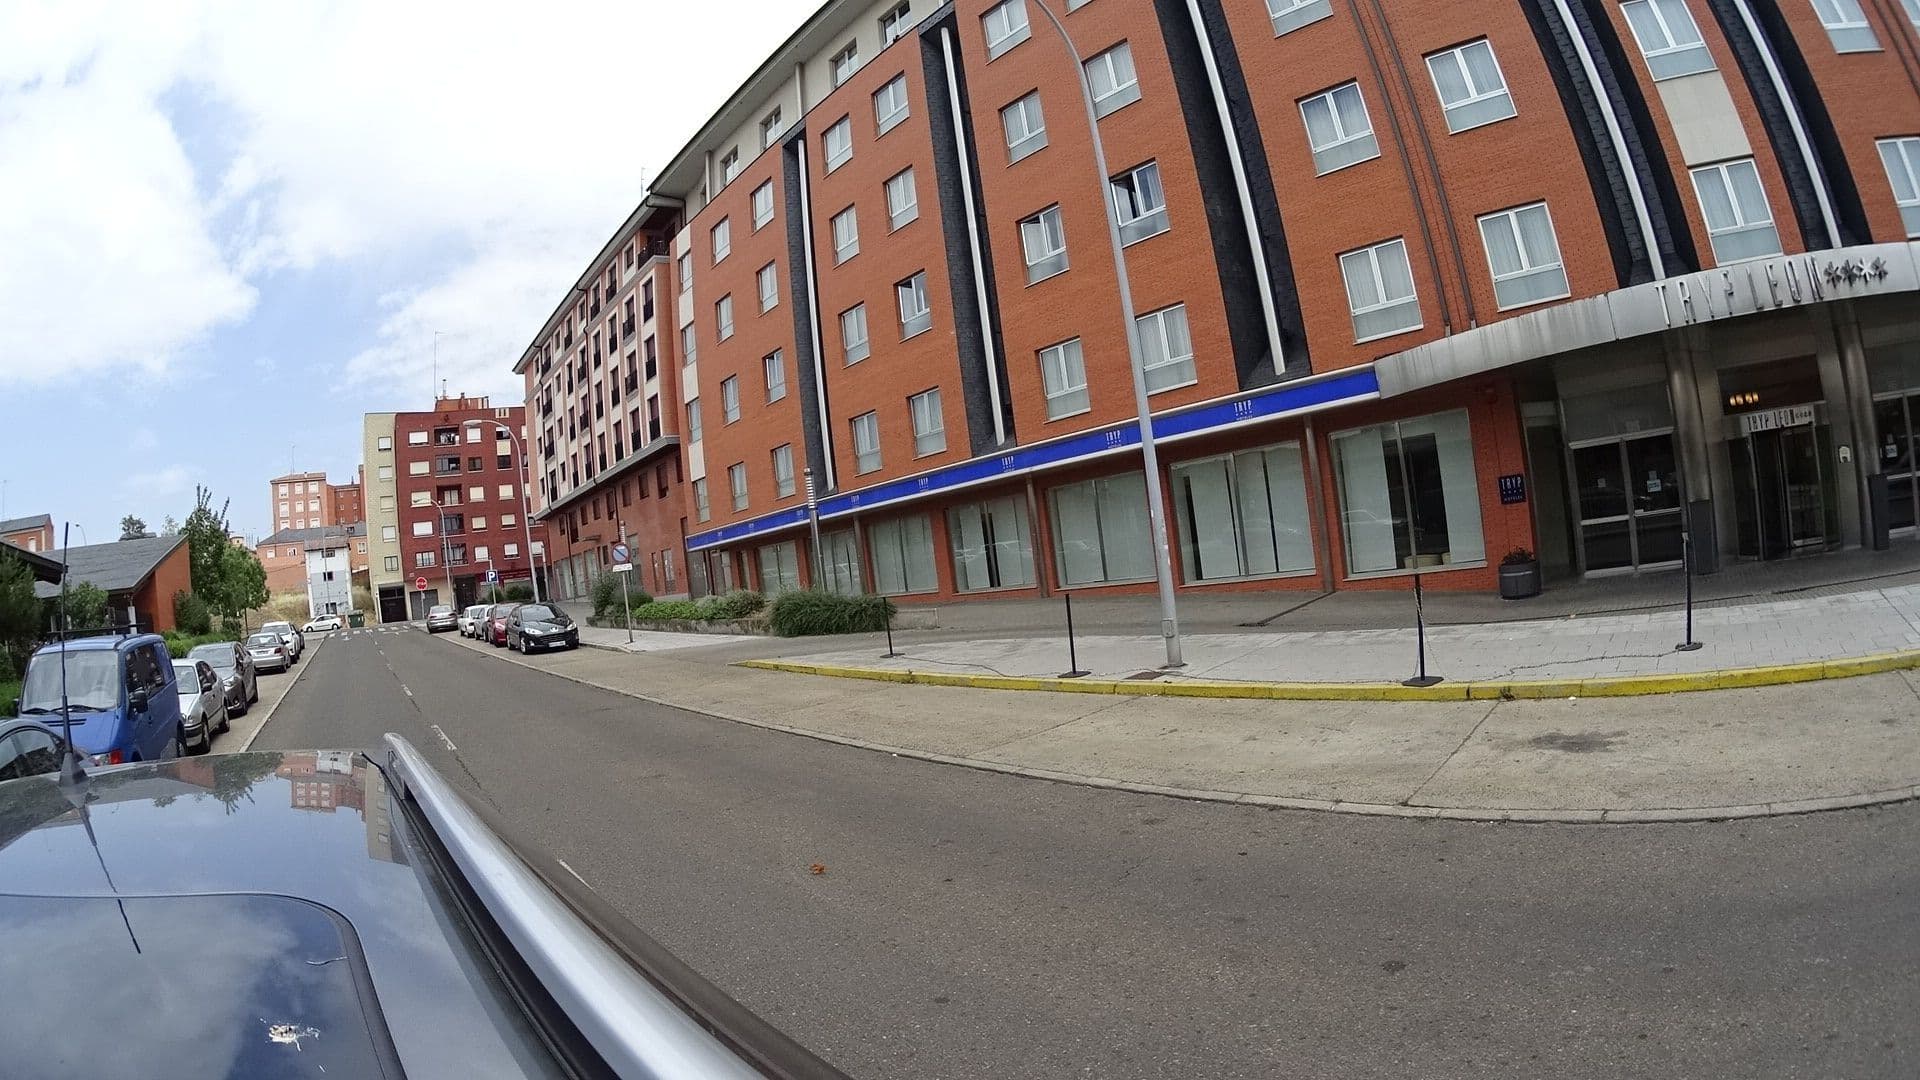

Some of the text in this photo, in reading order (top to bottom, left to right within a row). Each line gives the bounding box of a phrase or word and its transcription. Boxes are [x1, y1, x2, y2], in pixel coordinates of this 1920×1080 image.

[1654, 255, 1824, 327] TRYP LEON
[488, 571, 496, 581] P
